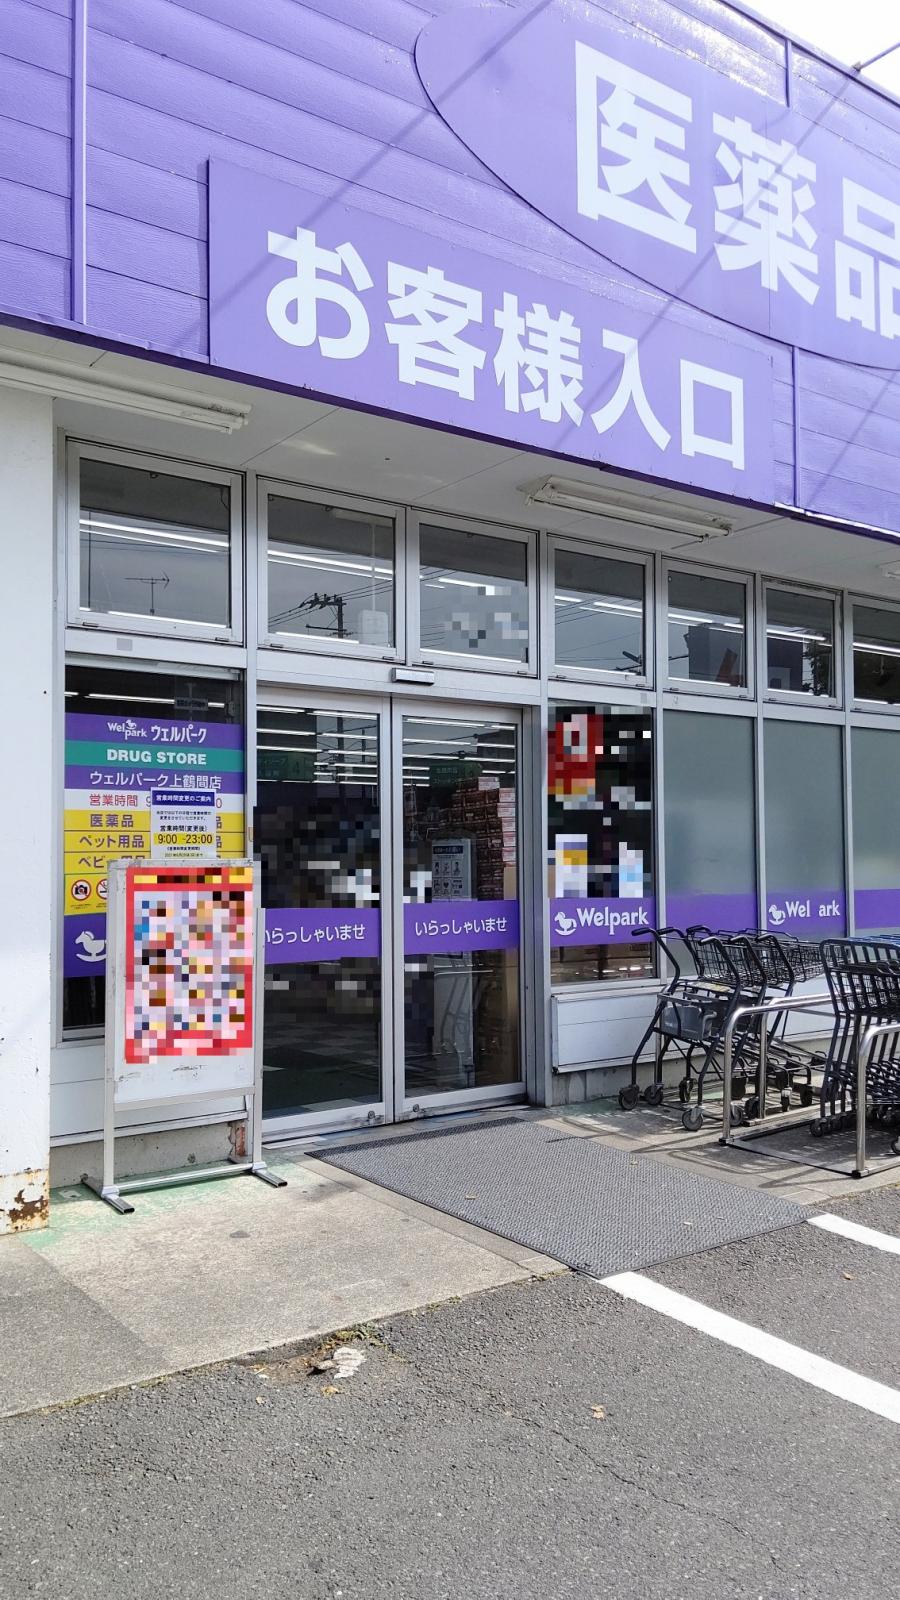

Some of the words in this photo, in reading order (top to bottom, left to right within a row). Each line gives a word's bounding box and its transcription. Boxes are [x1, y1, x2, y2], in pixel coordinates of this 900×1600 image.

[266, 227, 745, 470] お客様入口
[151, 724, 207, 743] ウェルパーク
[106, 749, 151, 763] DRUG
[156, 752, 207, 765] STORE
[90, 771, 222, 789] ウェルパーク上鶴間店
[89, 794, 138, 807] 営業時間
[90, 813, 134, 828] 医薬品
[79, 834, 145, 848] ペット用品
[157, 834, 178, 844] 9:00
[415, 917, 508, 937] いらっしゃいませ
[576, 906, 649, 935] Welpark
